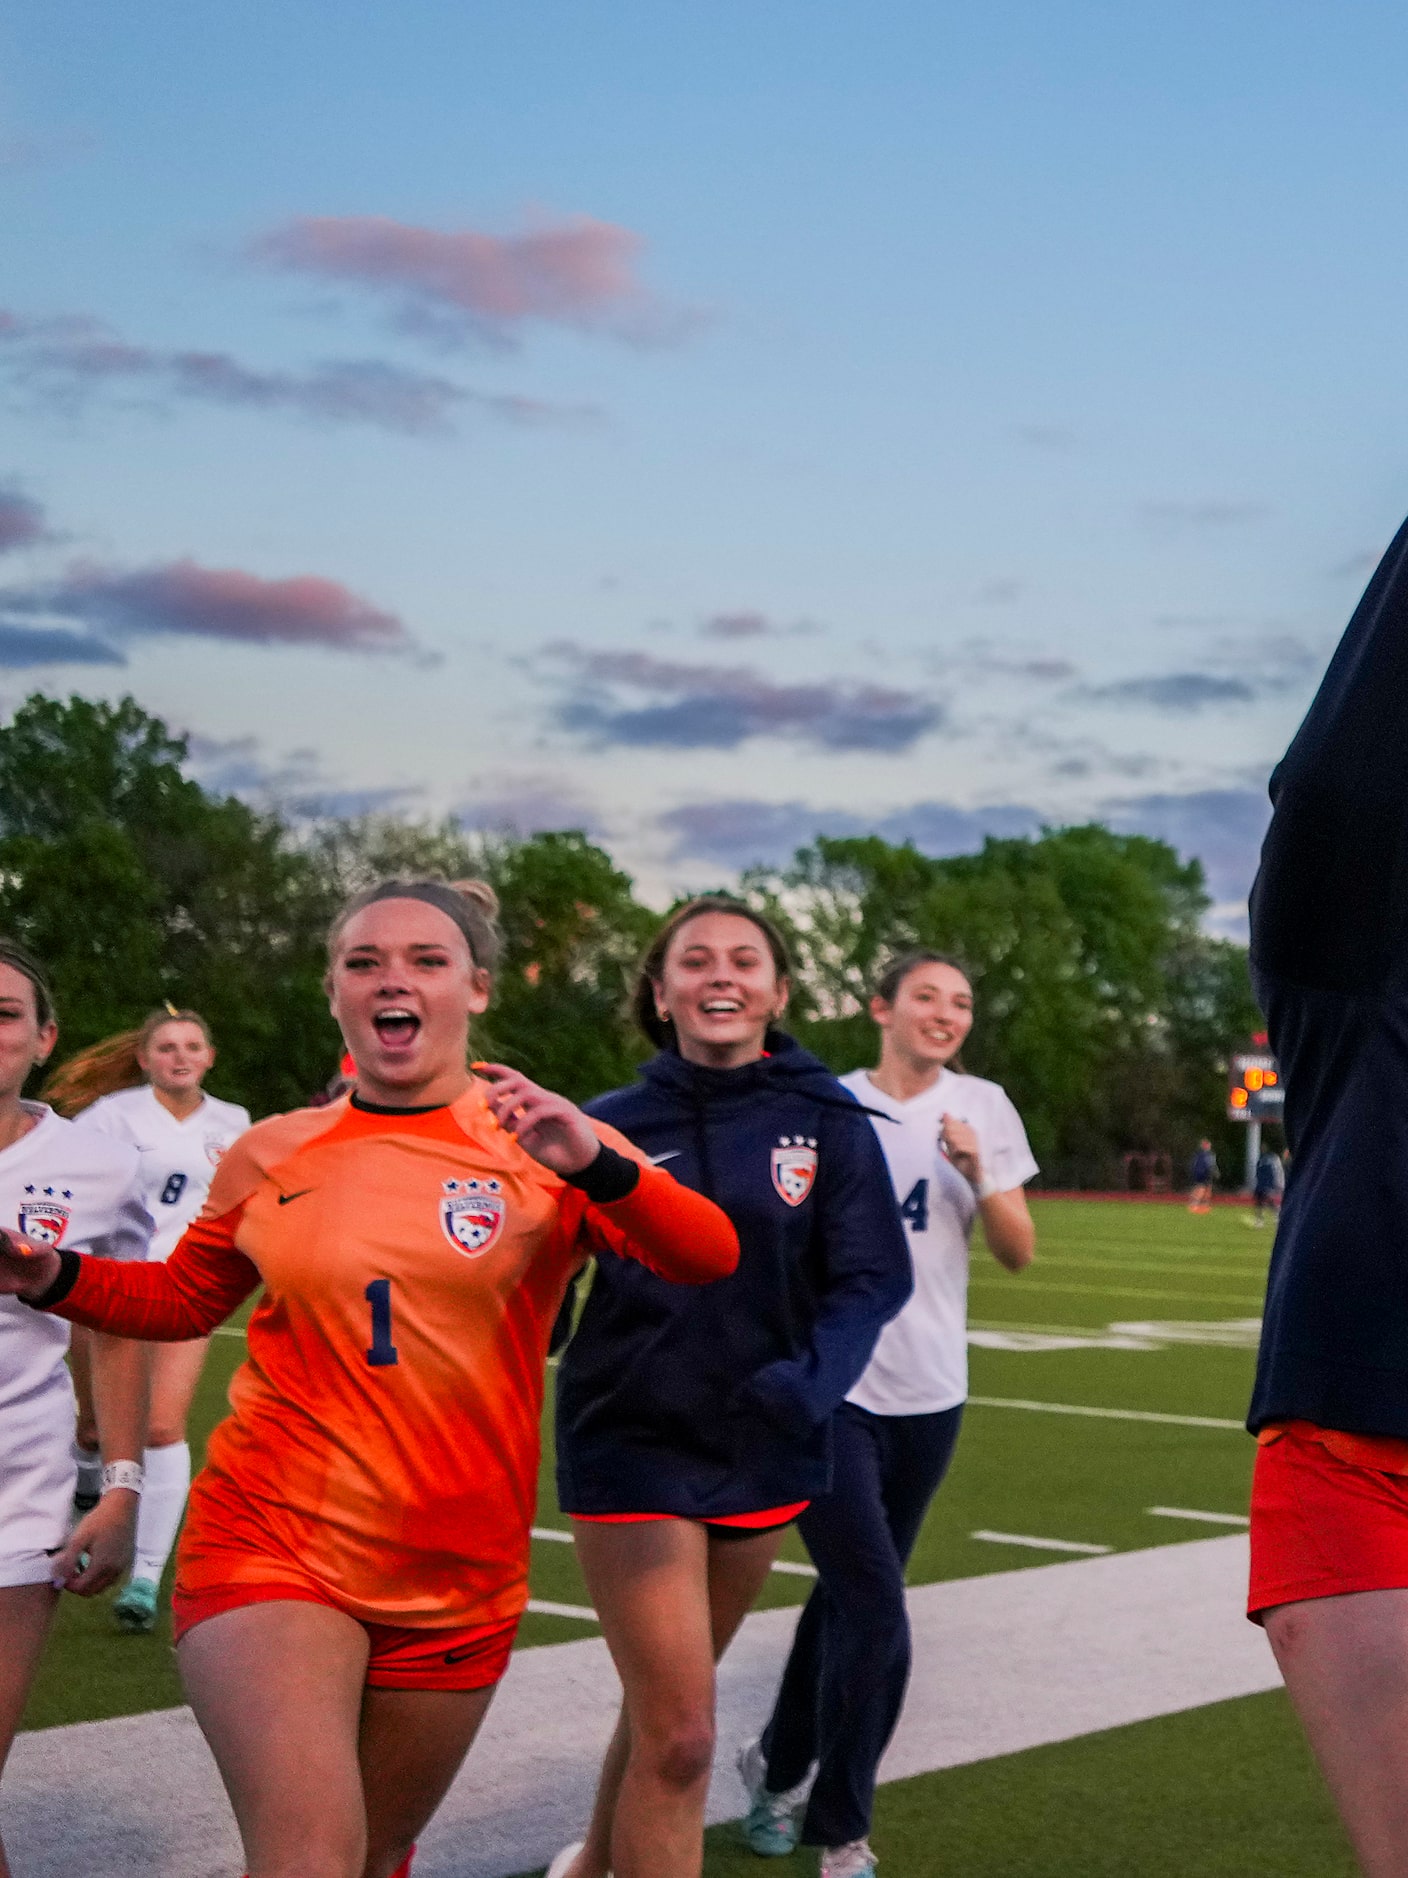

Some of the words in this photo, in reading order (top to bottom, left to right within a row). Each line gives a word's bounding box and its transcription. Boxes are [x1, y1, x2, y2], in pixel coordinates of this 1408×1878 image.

[160, 1173, 188, 1205] 8
[901, 1178, 930, 1232] 4
[365, 1278, 398, 1366] 1
